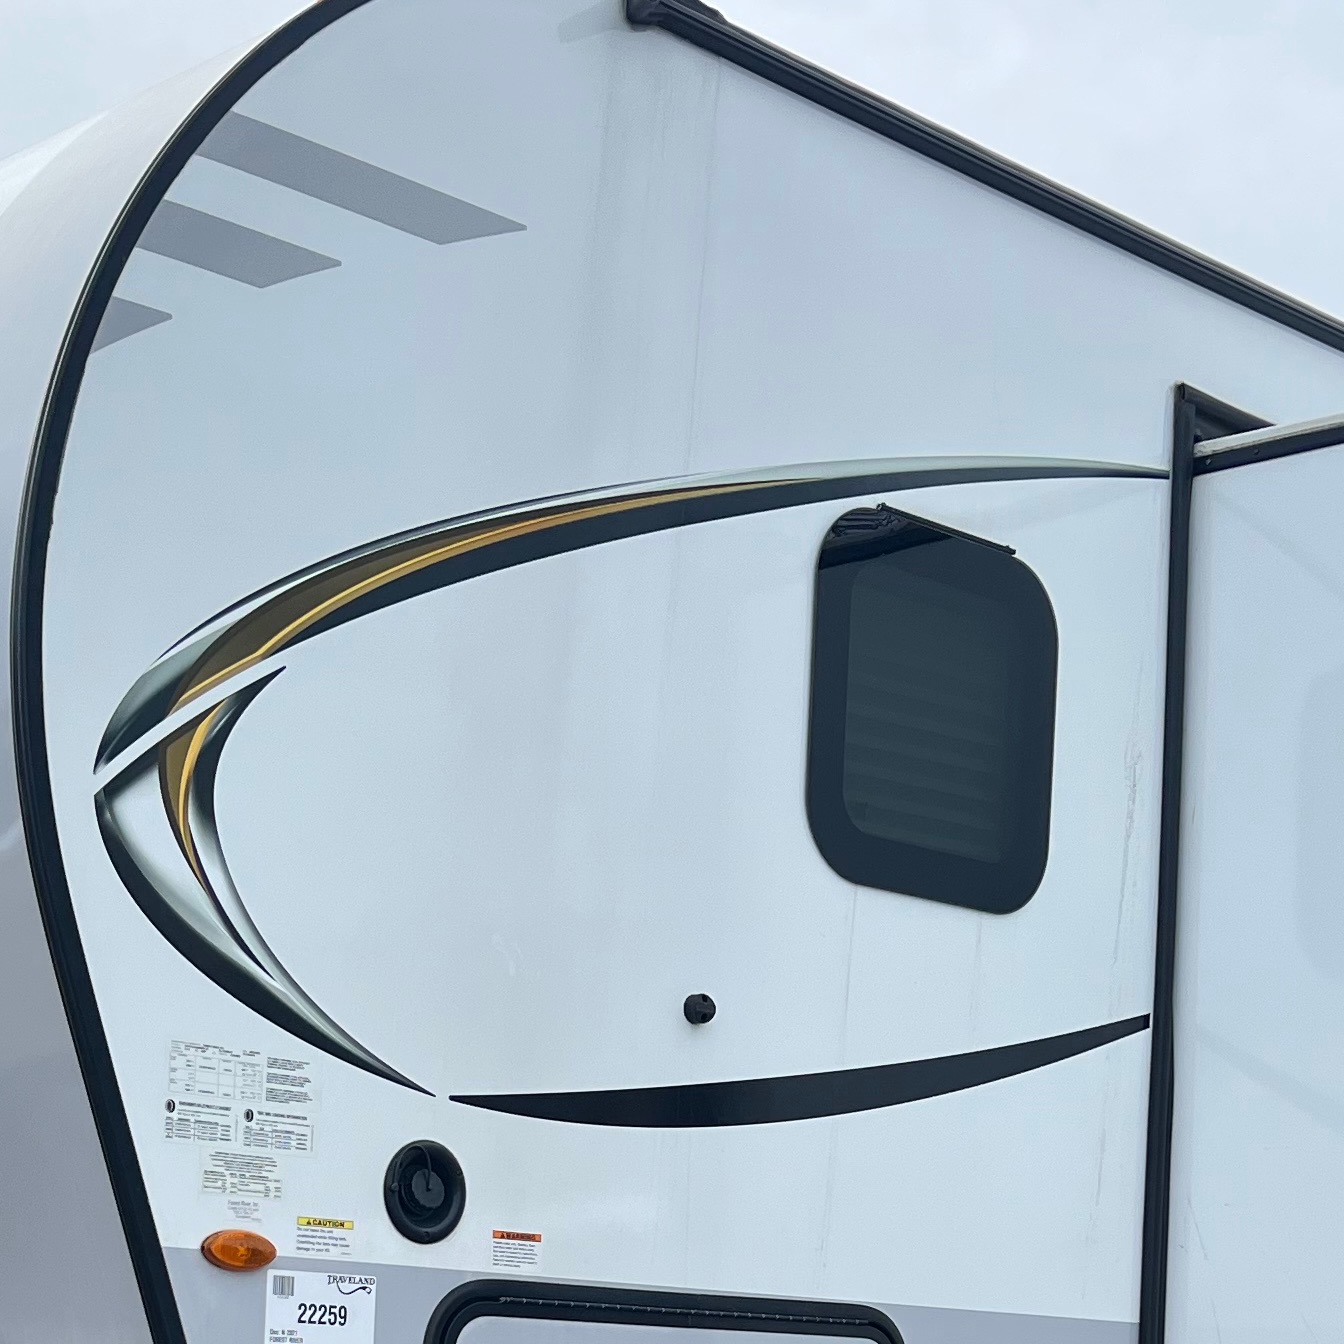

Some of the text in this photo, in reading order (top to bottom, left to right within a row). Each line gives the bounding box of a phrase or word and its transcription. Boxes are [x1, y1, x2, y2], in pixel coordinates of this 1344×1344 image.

[312, 1219, 345, 1228] CAUTION
[327, 1275, 375, 1286] TRAVELAND
[297, 1303, 347, 1326] 22259
